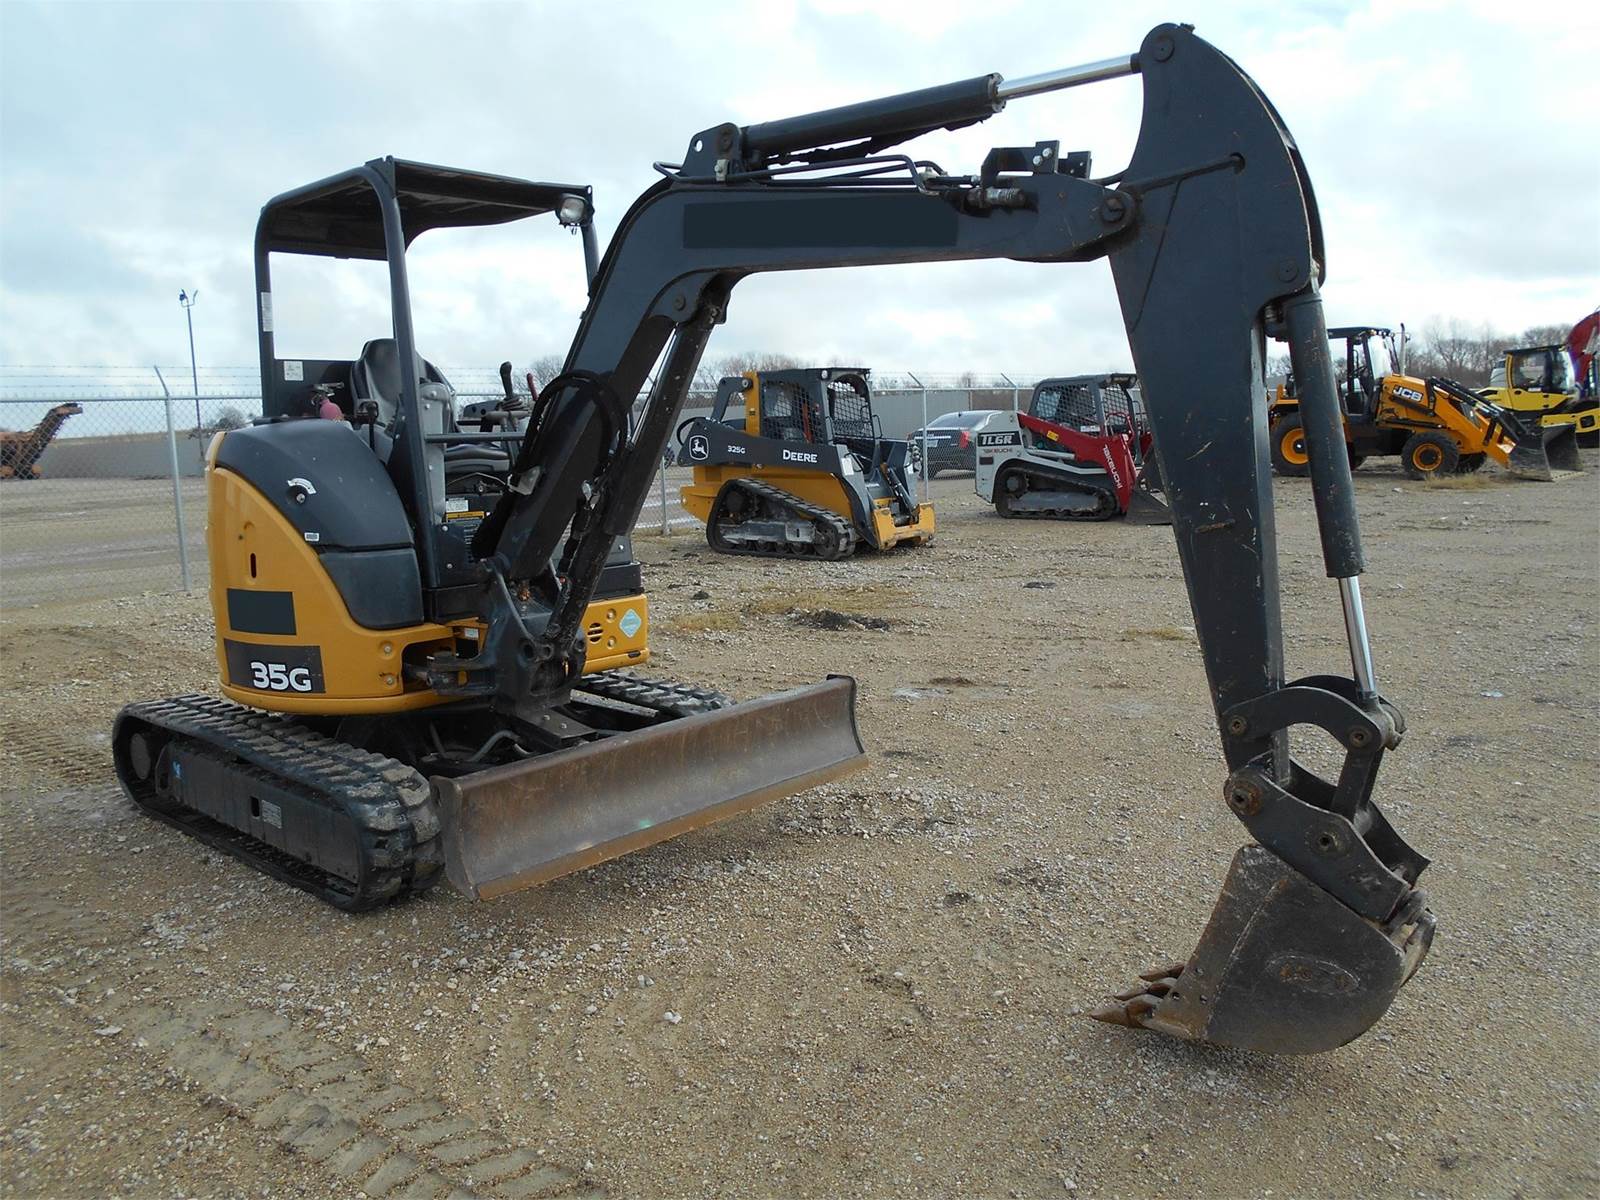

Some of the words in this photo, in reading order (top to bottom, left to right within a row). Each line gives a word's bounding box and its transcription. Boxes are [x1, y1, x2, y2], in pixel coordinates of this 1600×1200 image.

[1393, 386, 1422, 401] JCB
[981, 433, 1015, 445] TL6R
[728, 445, 746, 454] 325G
[782, 449, 818, 463] DEERE
[250, 661, 312, 692] 35G
